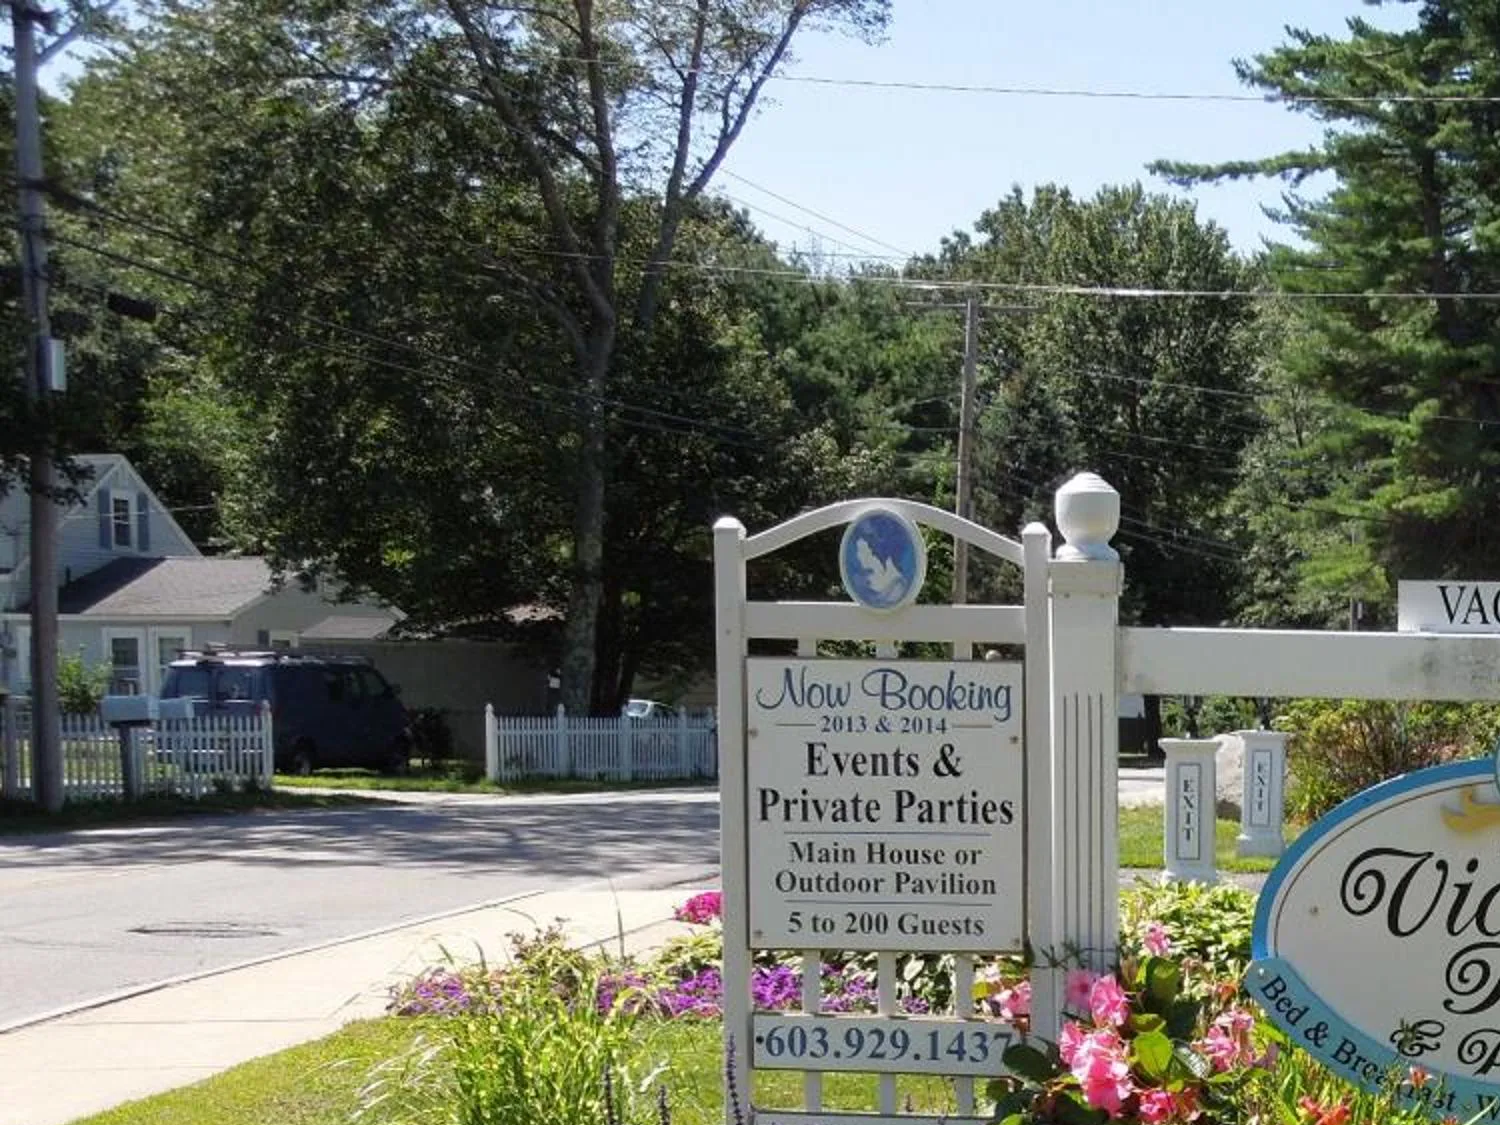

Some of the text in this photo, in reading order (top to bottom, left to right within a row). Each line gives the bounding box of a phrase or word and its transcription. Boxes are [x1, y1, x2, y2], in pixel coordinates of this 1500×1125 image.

[756, 667, 1013, 722] Now Booking
[820, 715, 948, 735] 2013 & 2014
[804, 742, 962, 778] Events &
[758, 787, 1014, 825] Private Parties
[788, 841, 983, 866] Main House or
[775, 870, 997, 896] Outdoor Pavilion
[788, 911, 985, 936] 5 to 200 Guests
[1260, 975, 1310, 1027] Bed
[1304, 1021, 1329, 1048] &
[765, 1024, 1013, 1063] 603.929.1437
